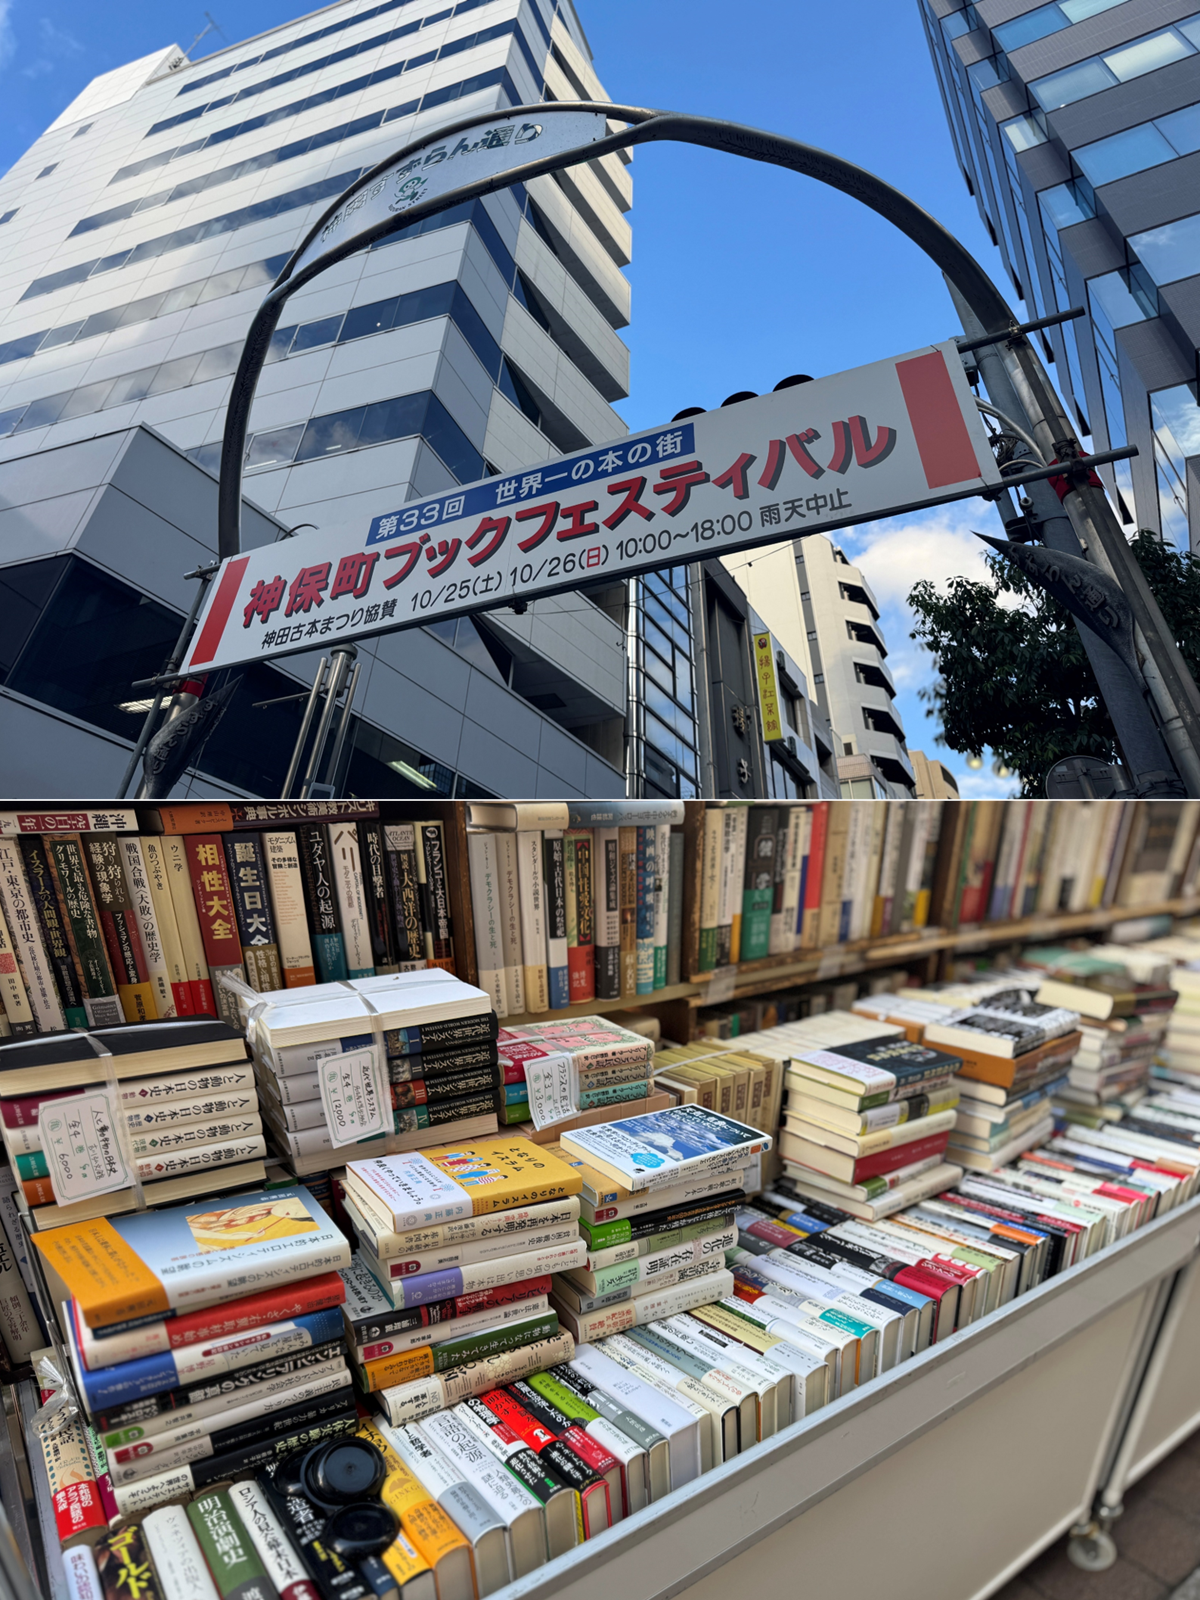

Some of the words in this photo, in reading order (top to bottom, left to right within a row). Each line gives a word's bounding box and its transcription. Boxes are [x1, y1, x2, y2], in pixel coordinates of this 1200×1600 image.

[374, 494, 466, 541] 第33回
[495, 430, 684, 505] 世界一の本の街
[243, 414, 897, 630] 神保町ブックフェスティバル
[260, 599, 398, 651] 神田古本まつり協賛
[410, 571, 503, 613] 10/25(土)
[760, 488, 853, 528] 雨天中止
[20, 814, 88, 831] 空白の一年
[91, 812, 127, 831] 沖縄
[246, 800, 376, 821] キリスト教美術シンボル事典
[267, 836, 296, 845] モダニズム
[270, 845, 284, 854] 建築
[101, 841, 125, 904] 狩り狩られる
[147, 843, 164, 891] 魚のつぶやき
[170, 844, 184, 873] ウニ学
[366, 832, 385, 899] 時代の目撃者
[55, 844, 82, 919] グリモワールの歴史
[89, 843, 114, 904] 経験の現象学
[309, 831, 336, 931] ユダヤ人の起源
[531, 840, 540, 911] スタンダールの小説世界
[29, 850, 68, 958] イスラームの人間観・世界観
[125, 843, 162, 964] 戦国合戦〈大敗〉の歴史学
[195, 844, 233, 940] 相性大全
[430, 839, 449, 940] フランコと大日本帝国
[577, 850, 590, 935] 中国性愛文化
[484, 872, 498, 949] デモクラシーの生と死
[506, 870, 518, 946] デモクラシーの生と死
[410, 1037, 420, 1045] I
[421, 1023, 491, 1044] 近代世界システム
[423, 1050, 491, 1072] 近代世界システム
[148, 1072, 247, 1098] 人と動物の日本史
[415, 1088, 426, 1099] III
[426, 1074, 493, 1096] 近代世界システム
[557, 1062, 571, 1115] フランスの民話
[153, 1097, 251, 1123] 人と動物の日本史
[418, 1114, 428, 1125] IV
[429, 1099, 494, 1122] 近代世界システム
[158, 1120, 254, 1148] 人と動物の日本史
[163, 1143, 259, 1172] 人と動物の日本史
[491, 1151, 522, 1172] イスラム
[508, 1146, 546, 1169] となりの
[492, 1186, 566, 1208] となりのイスラム
[682, 1176, 738, 1198] 紅白歌合戦と日本人
[424, 1206, 464, 1222] 内藤正典
[480, 1210, 572, 1237] 日本を再発明する
[397, 1240, 440, 1254] 日本研究の
[404, 1231, 440, 1243] 基本図書
[527, 1230, 571, 1246] 貧困の戦後史
[698, 1232, 736, 1255] 進化の
[161, 1234, 334, 1276] 日本的エロティシズムの眺望
[641, 1247, 696, 1276] 存在証明
[226, 1255, 342, 1288] 日本的エロティシズムの眺望
[674, 1258, 722, 1282] 寺院消滅
[458, 1284, 547, 1317] シビリアンの戦争
[503, 1300, 540, 1318] 憲法と世論
[172, 1303, 303, 1345] やくざ・右翼取材事始め
[228, 1331, 304, 1361] 彗星を見ていた
[450, 1325, 551, 1361] 動物になって生きてみた
[189, 1348, 341, 1403] エンジニアリングの真髄
[266, 1364, 336, 1391] プライドの社会学
[263, 1378, 342, 1411] 民主主義のつくり方
[318, 1399, 349, 1414] アメリカ
[273, 1410, 318, 1430] 暴力の世紀
[274, 1418, 356, 1453] 人体実験の歴史
[433, 1414, 487, 1464] 言語の起源
[509, 1455, 538, 1487] 進化させた
[77, 1482, 94, 1507] 本邦初の
[126, 1472, 189, 1500] の世界へようこそ
[388, 1482, 424, 1506] GINKGO
[480, 1472, 508, 1500] 謎に迫る
[494, 1468, 533, 1507] 人類史最大の
[55, 1490, 69, 1513] 集大成
[198, 1495, 249, 1569] 明治演劇史
[240, 1486, 299, 1580] ロシア人の見た幕末日本
[108, 1525, 152, 1600] ゴールド
[164, 1515, 203, 1592] ヴェネツィアの出版人
